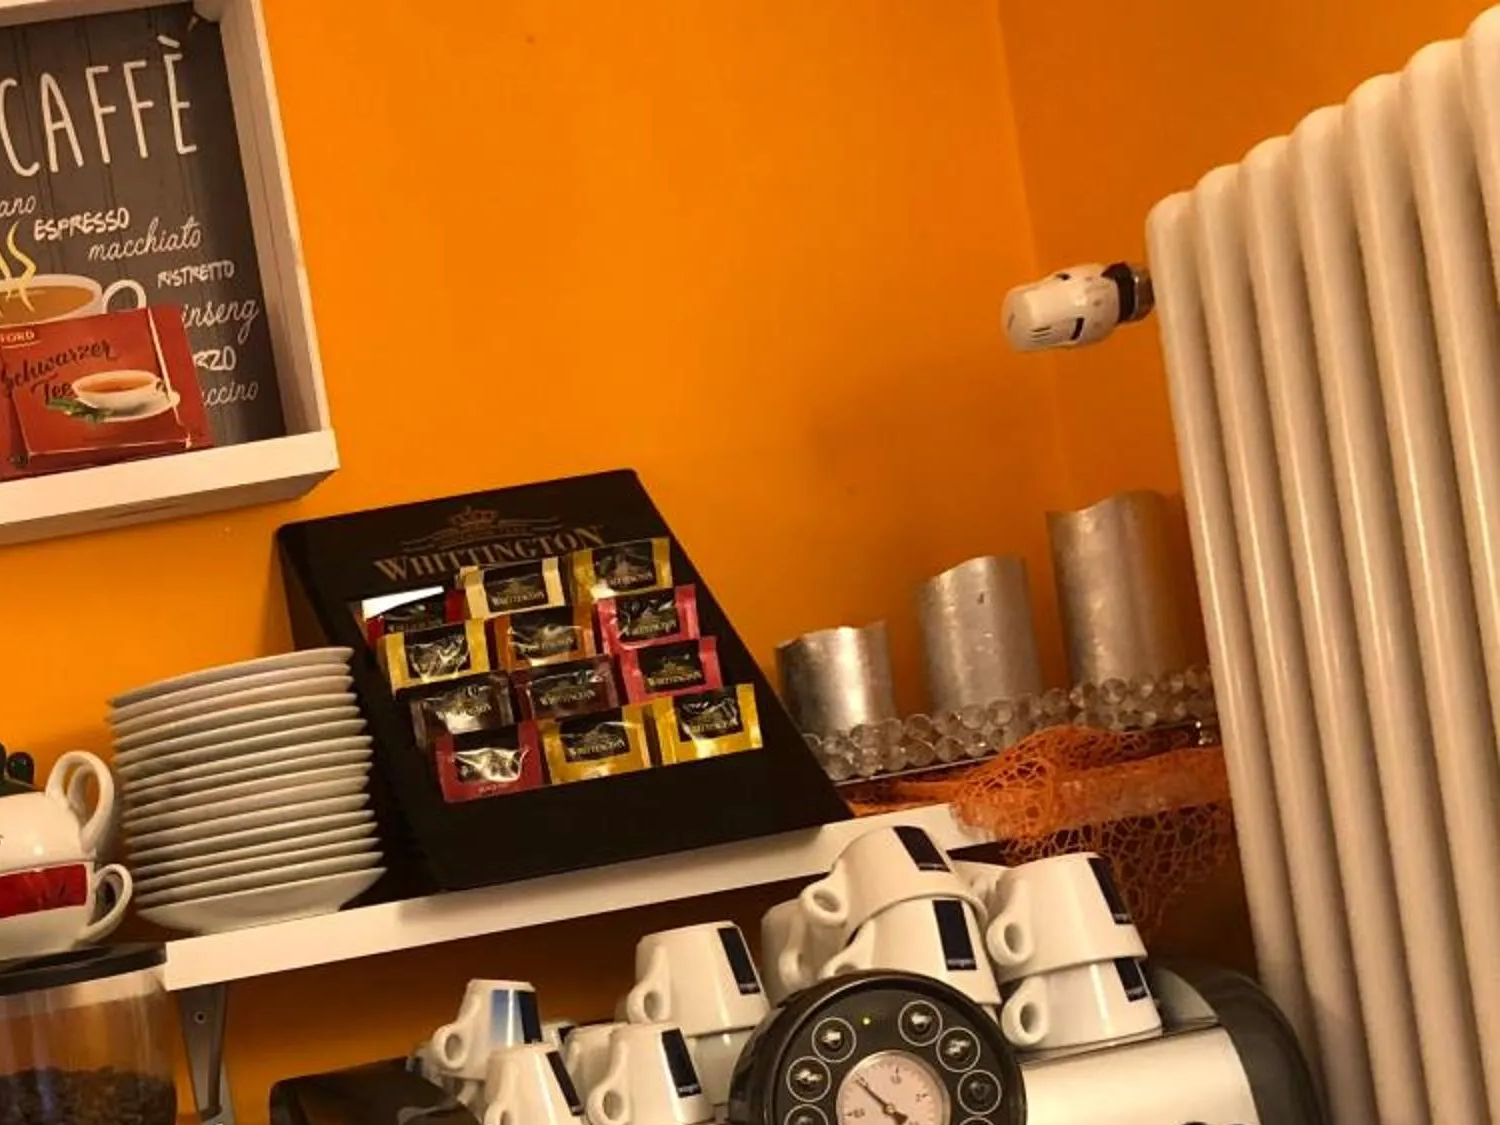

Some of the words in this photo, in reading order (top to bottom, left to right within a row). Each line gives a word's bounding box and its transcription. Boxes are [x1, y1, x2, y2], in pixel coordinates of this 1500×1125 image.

[33, 206, 131, 242] ESPRESSO
[87, 215, 202, 262] macchiato
[157, 259, 236, 289] RISTRETTO
[181, 299, 260, 346] inseng
[1, 339, 118, 399] Schwarzer
[192, 345, 237, 371] RZO
[373, 527, 606, 583] WHITTINGTON
